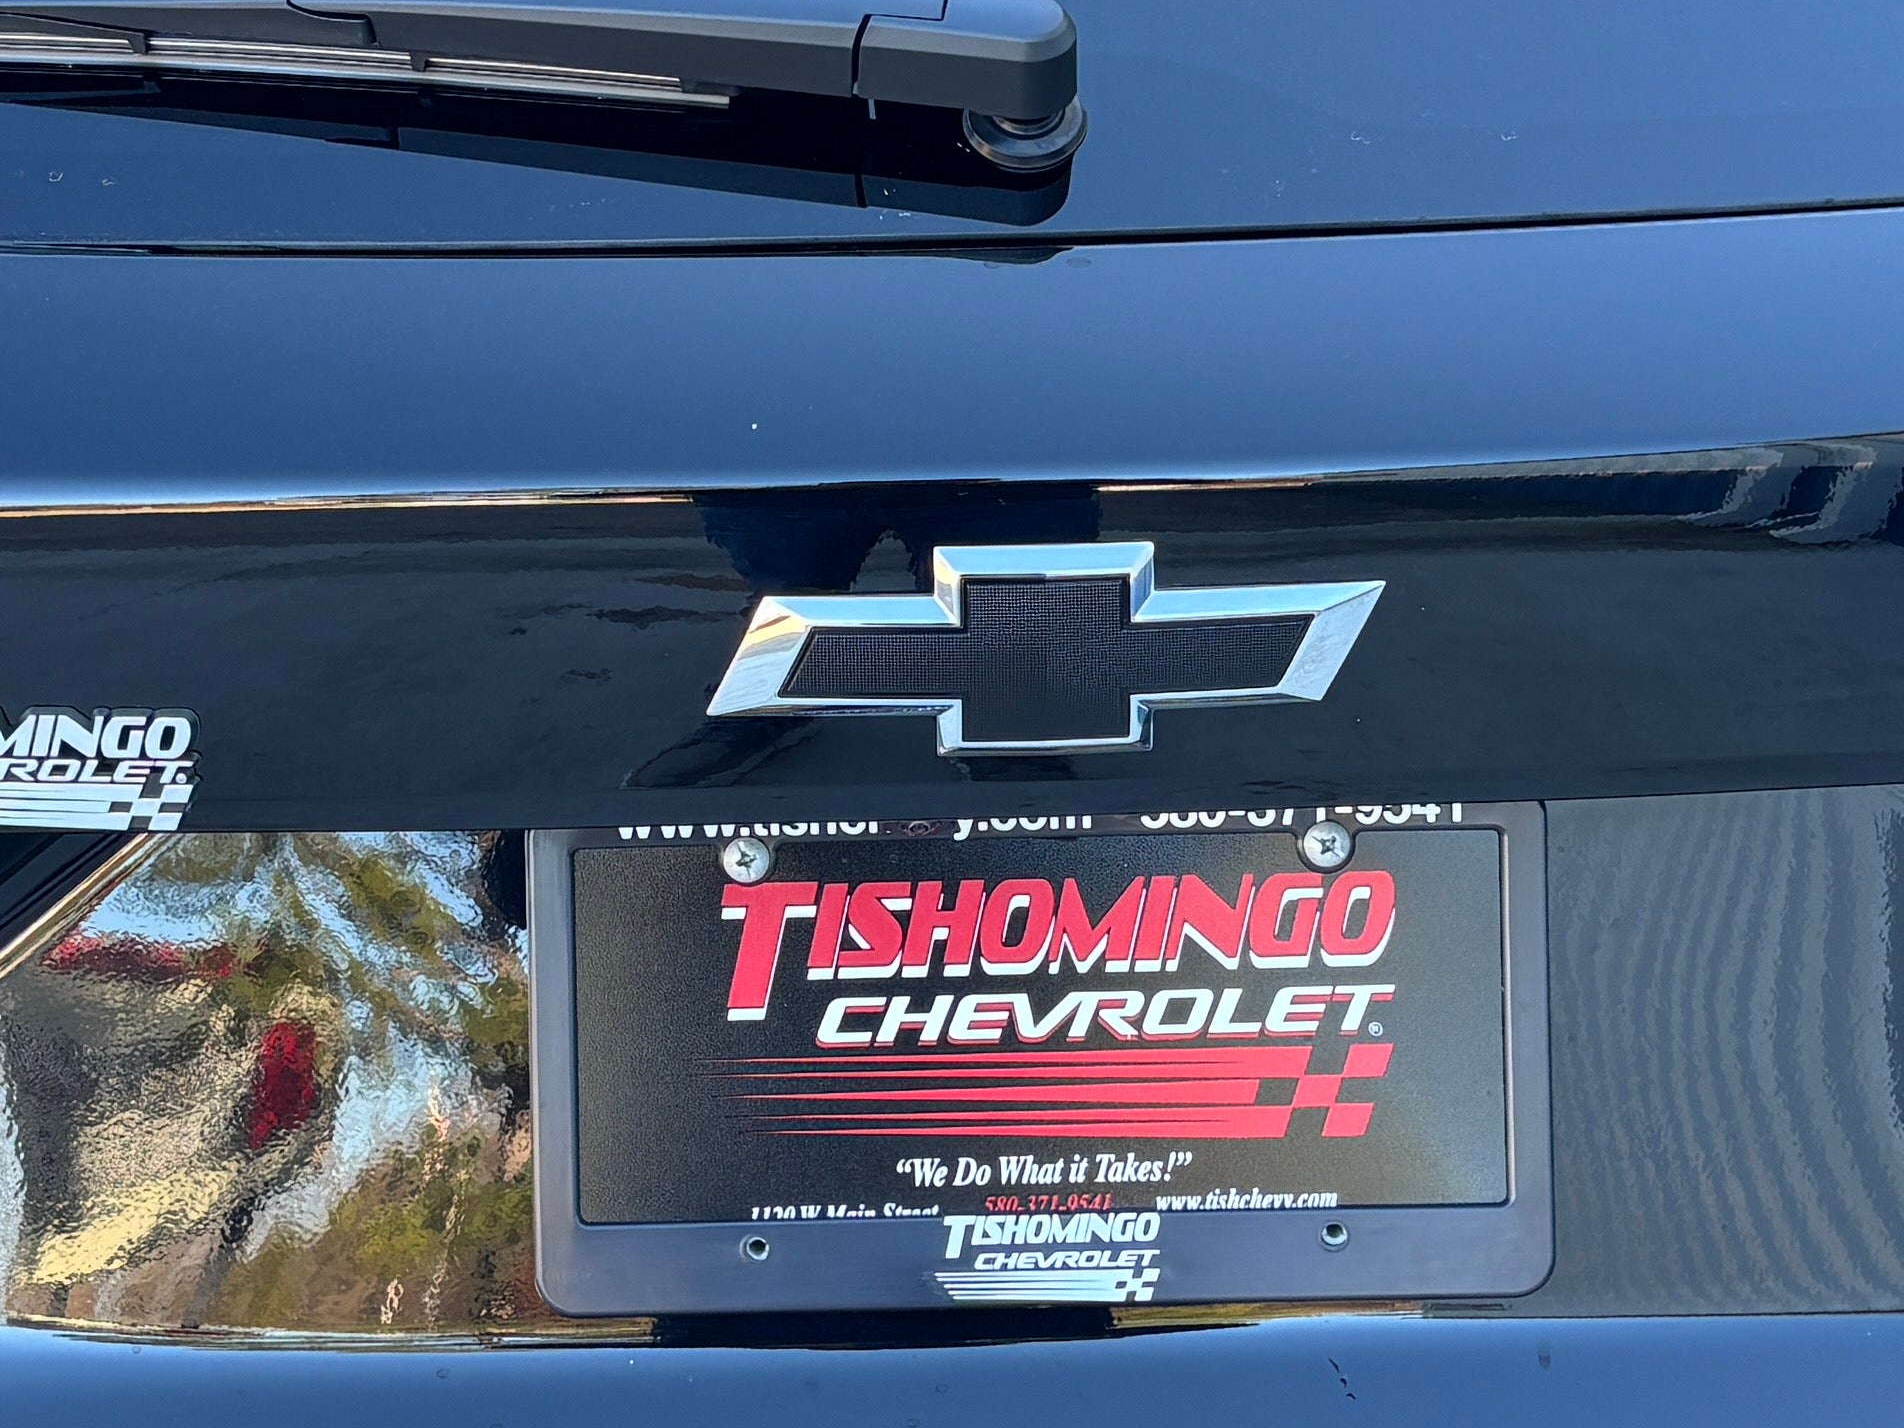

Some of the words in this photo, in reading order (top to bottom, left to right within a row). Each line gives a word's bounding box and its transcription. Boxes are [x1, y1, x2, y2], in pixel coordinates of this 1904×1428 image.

[721, 872, 1395, 1020] TISHOMINGO
[815, 984, 1395, 1047] CHEVROLET
[952, 1156, 992, 1186] Do
[999, 1154, 1064, 1185] What
[1068, 1153, 1089, 1184] it
[800, 1204, 822, 1219] W
[944, 1213, 1160, 1259] TISHOMINGO
[974, 1250, 1160, 1271] CHEVROLET
